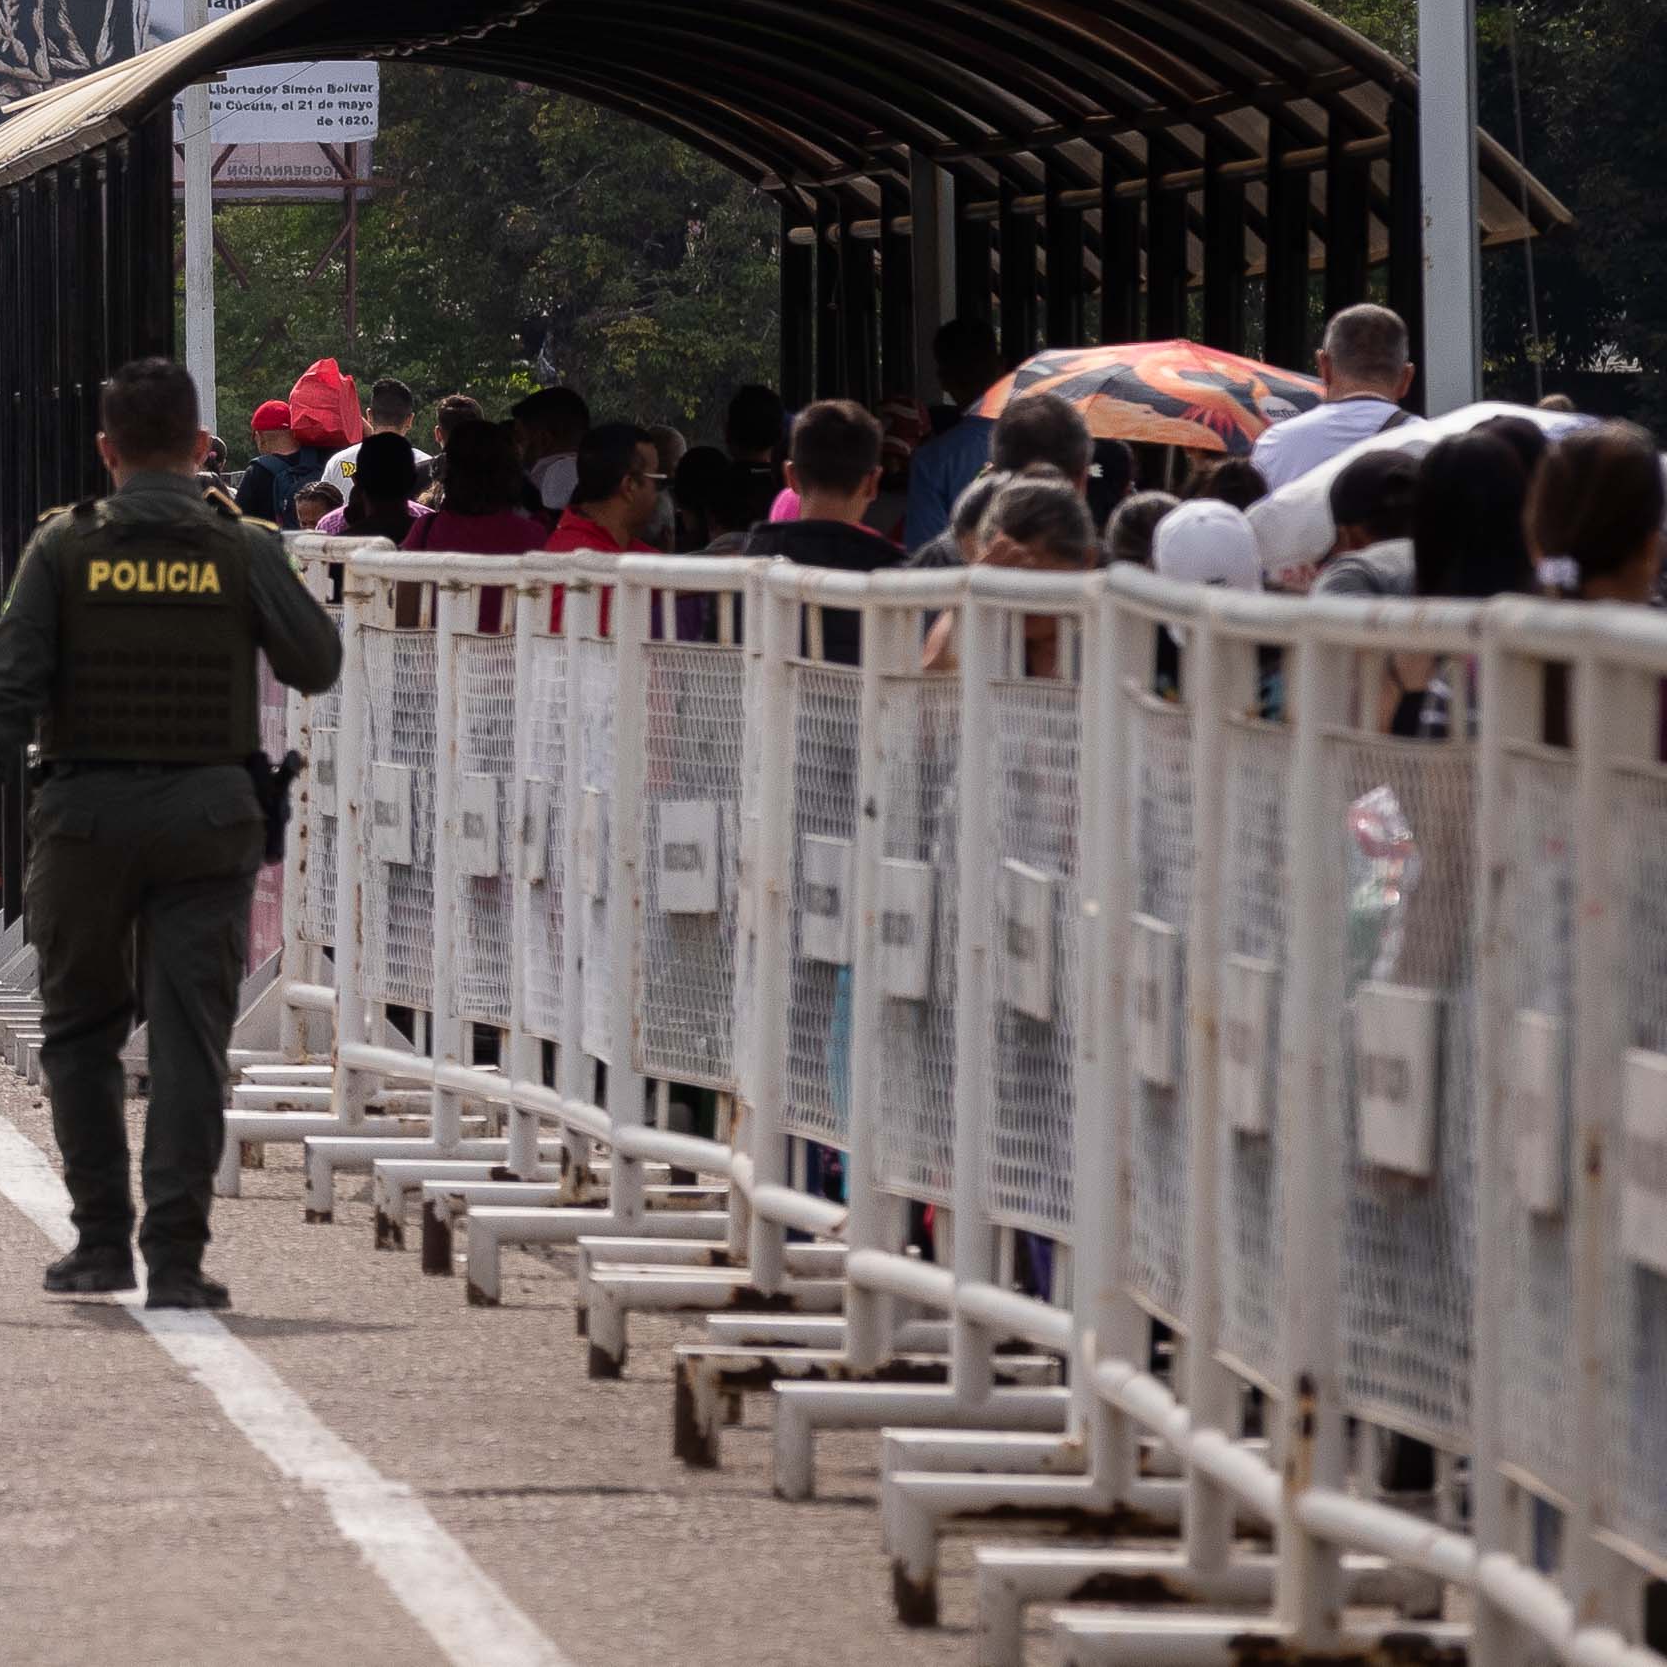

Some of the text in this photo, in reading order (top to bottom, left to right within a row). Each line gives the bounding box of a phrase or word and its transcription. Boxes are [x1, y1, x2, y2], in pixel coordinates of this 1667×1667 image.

[281, 83, 323, 94] Simón
[282, 100, 294, 111] el
[298, 100, 313, 111] 21
[318, 100, 333, 110] de
[338, 102, 373, 112] mayo
[317, 116, 373, 126] de 1820.
[89, 559, 221, 594] POLICIA
